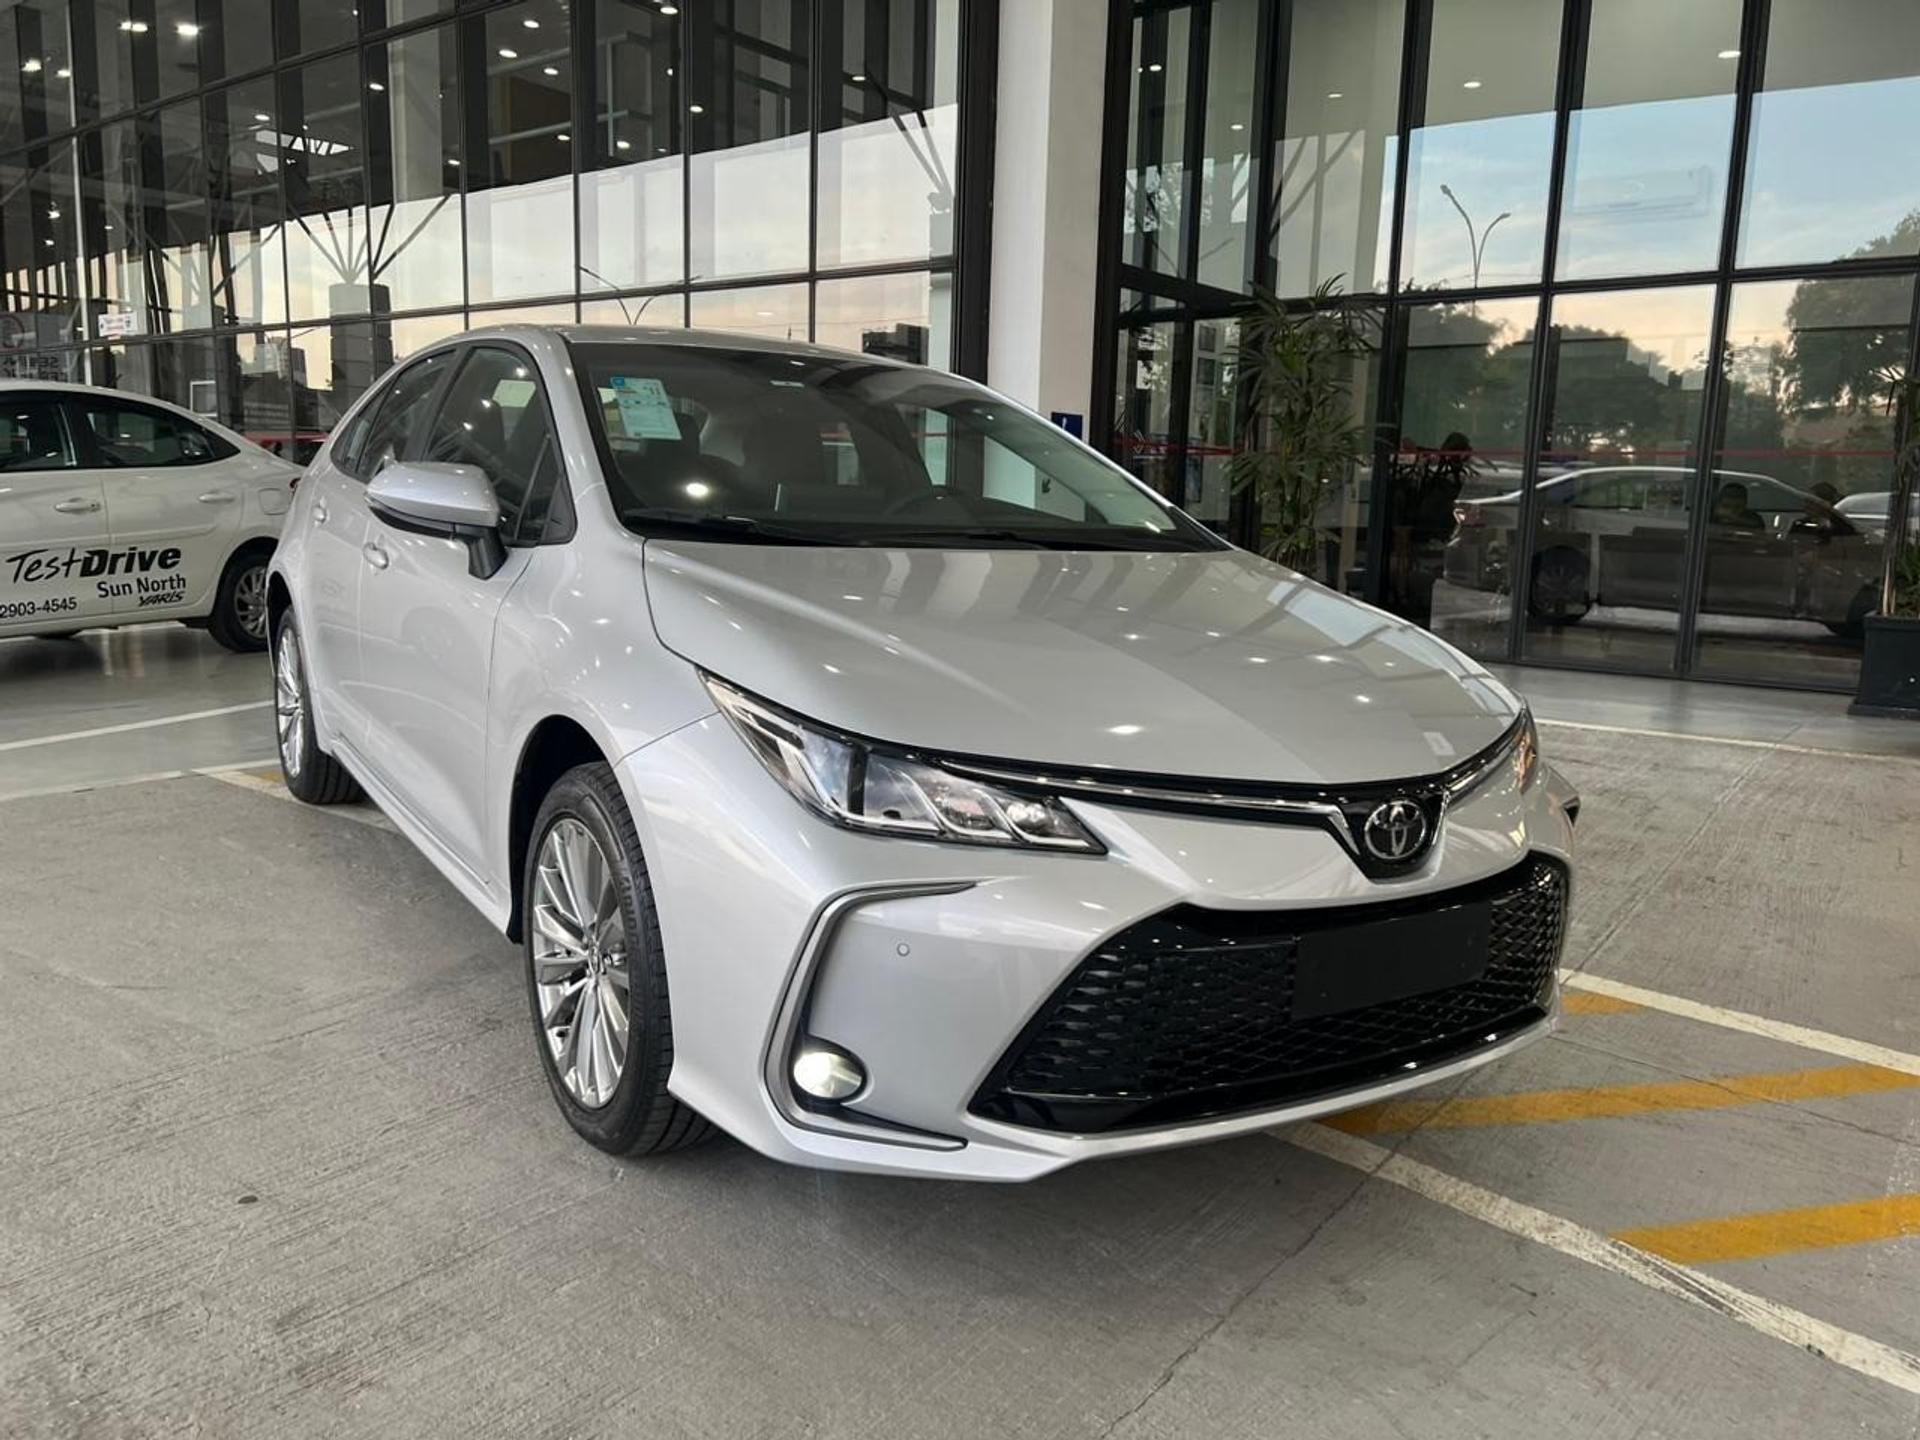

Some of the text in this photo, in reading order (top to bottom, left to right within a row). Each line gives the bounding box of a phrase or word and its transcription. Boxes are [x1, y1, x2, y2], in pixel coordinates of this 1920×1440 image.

[97, 574, 187, 599] Sun North
[0, 598, 77, 618] 2903-4545
[138, 591, 185, 607] YARIS
